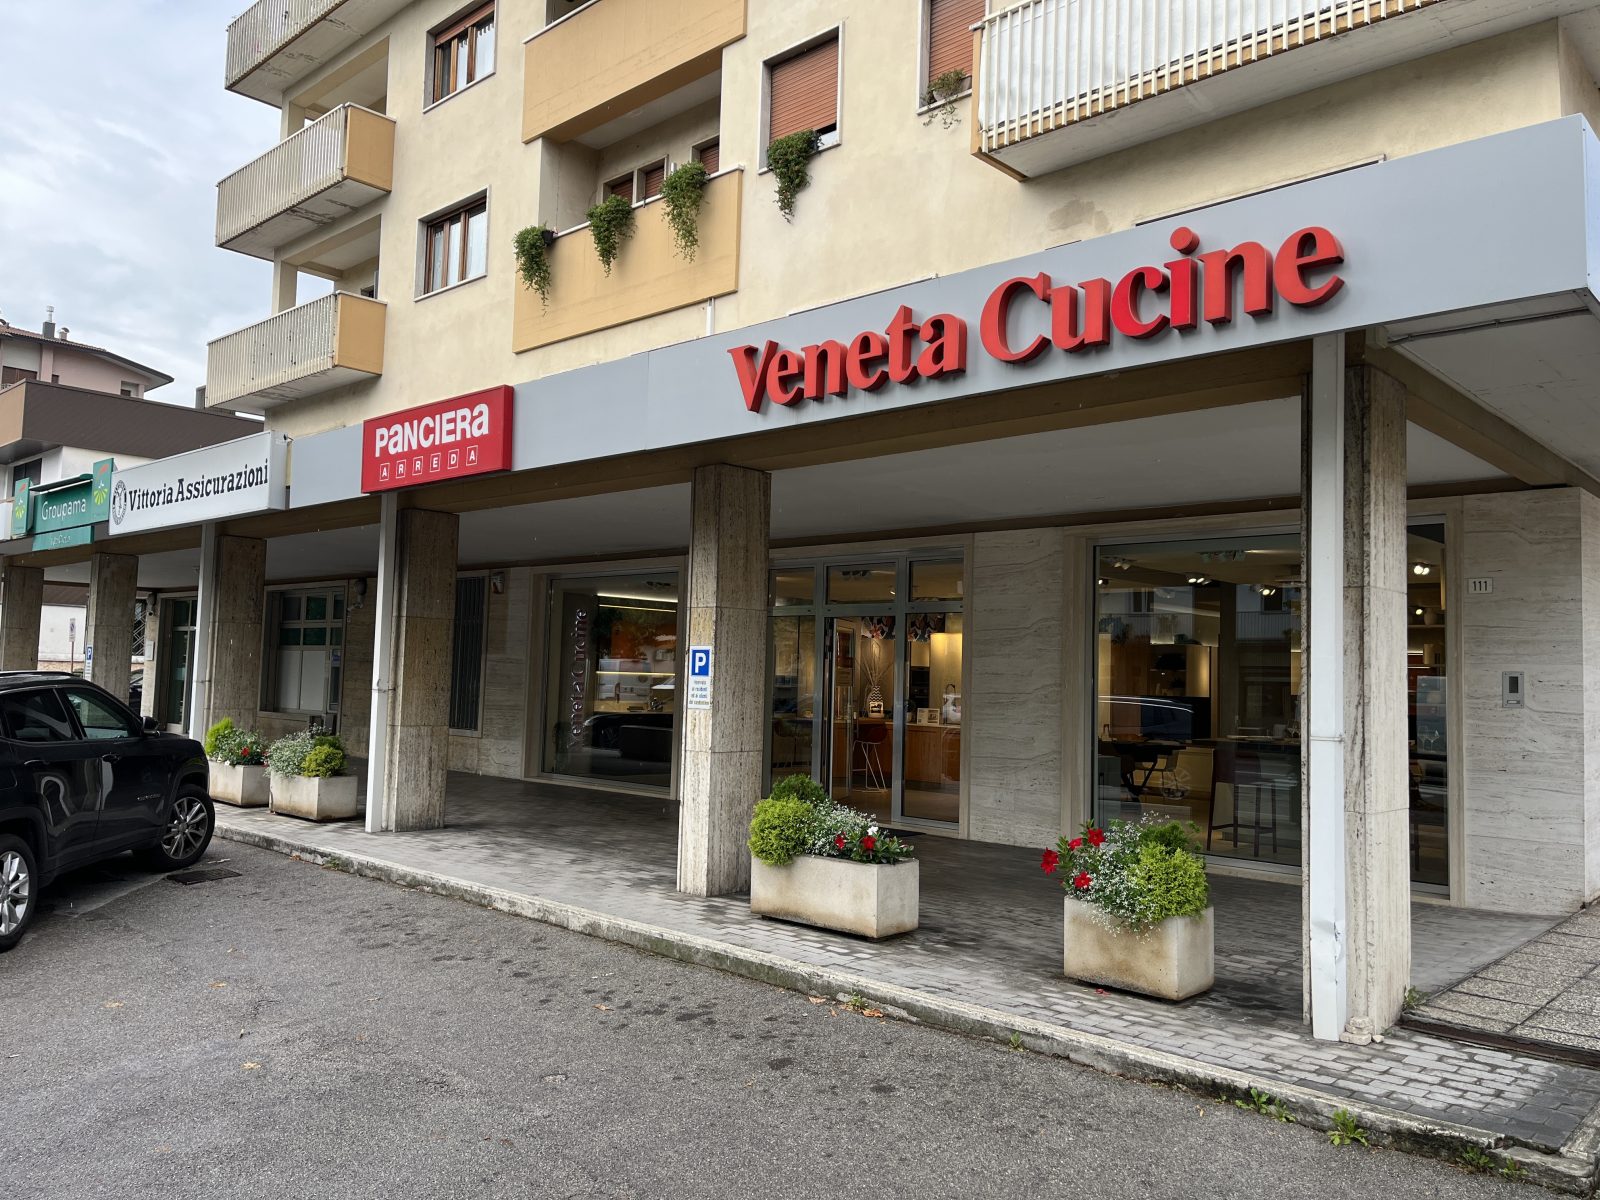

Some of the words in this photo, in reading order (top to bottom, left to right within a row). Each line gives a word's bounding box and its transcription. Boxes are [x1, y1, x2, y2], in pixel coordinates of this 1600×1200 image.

[726, 304, 967, 413] Veneta
[980, 227, 1345, 364] Cucine
[380, 448, 476, 478] ARREDA
[128, 483, 173, 511] Vittoria
[175, 458, 269, 503] Assicurazioni
[41, 498, 86, 521] Groupama
[1472, 580, 1488, 592] 111
[694, 652, 707, 674] P
